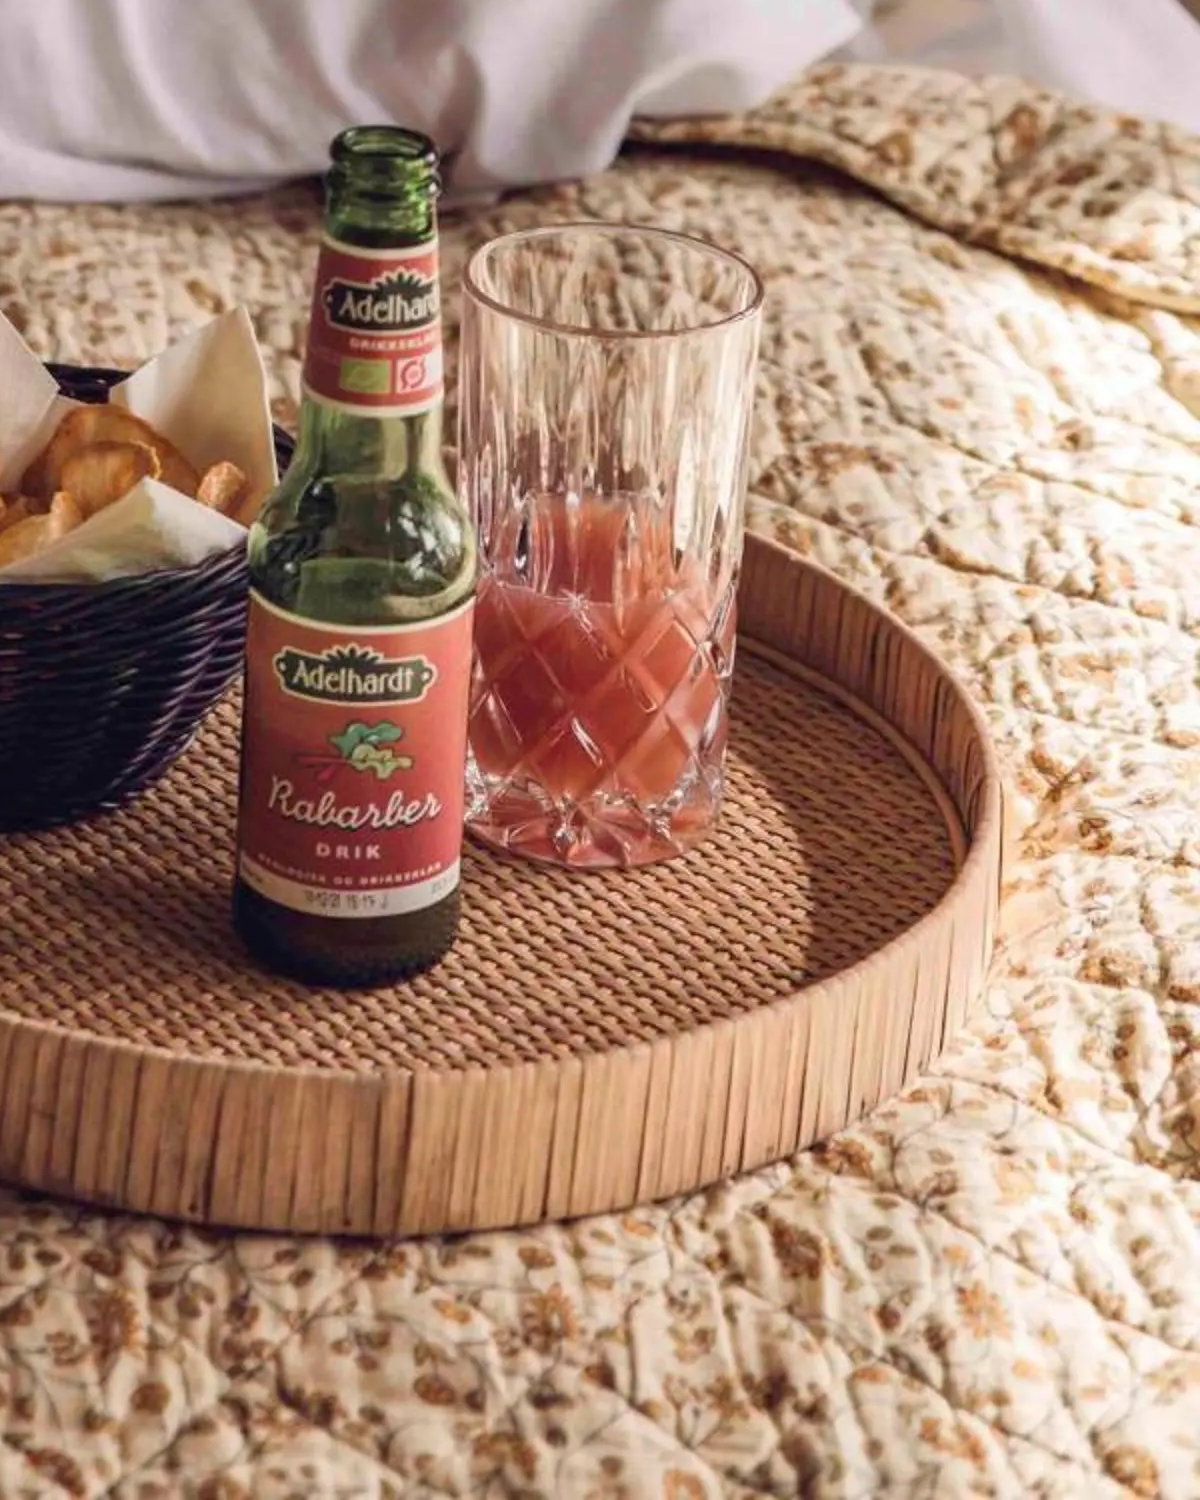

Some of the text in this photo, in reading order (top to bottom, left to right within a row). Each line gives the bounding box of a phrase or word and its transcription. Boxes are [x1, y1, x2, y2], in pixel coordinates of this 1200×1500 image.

[292, 659, 414, 695] Adelhardt
[267, 774, 442, 830] Rabarber
[315, 842, 382, 860] DRIK
